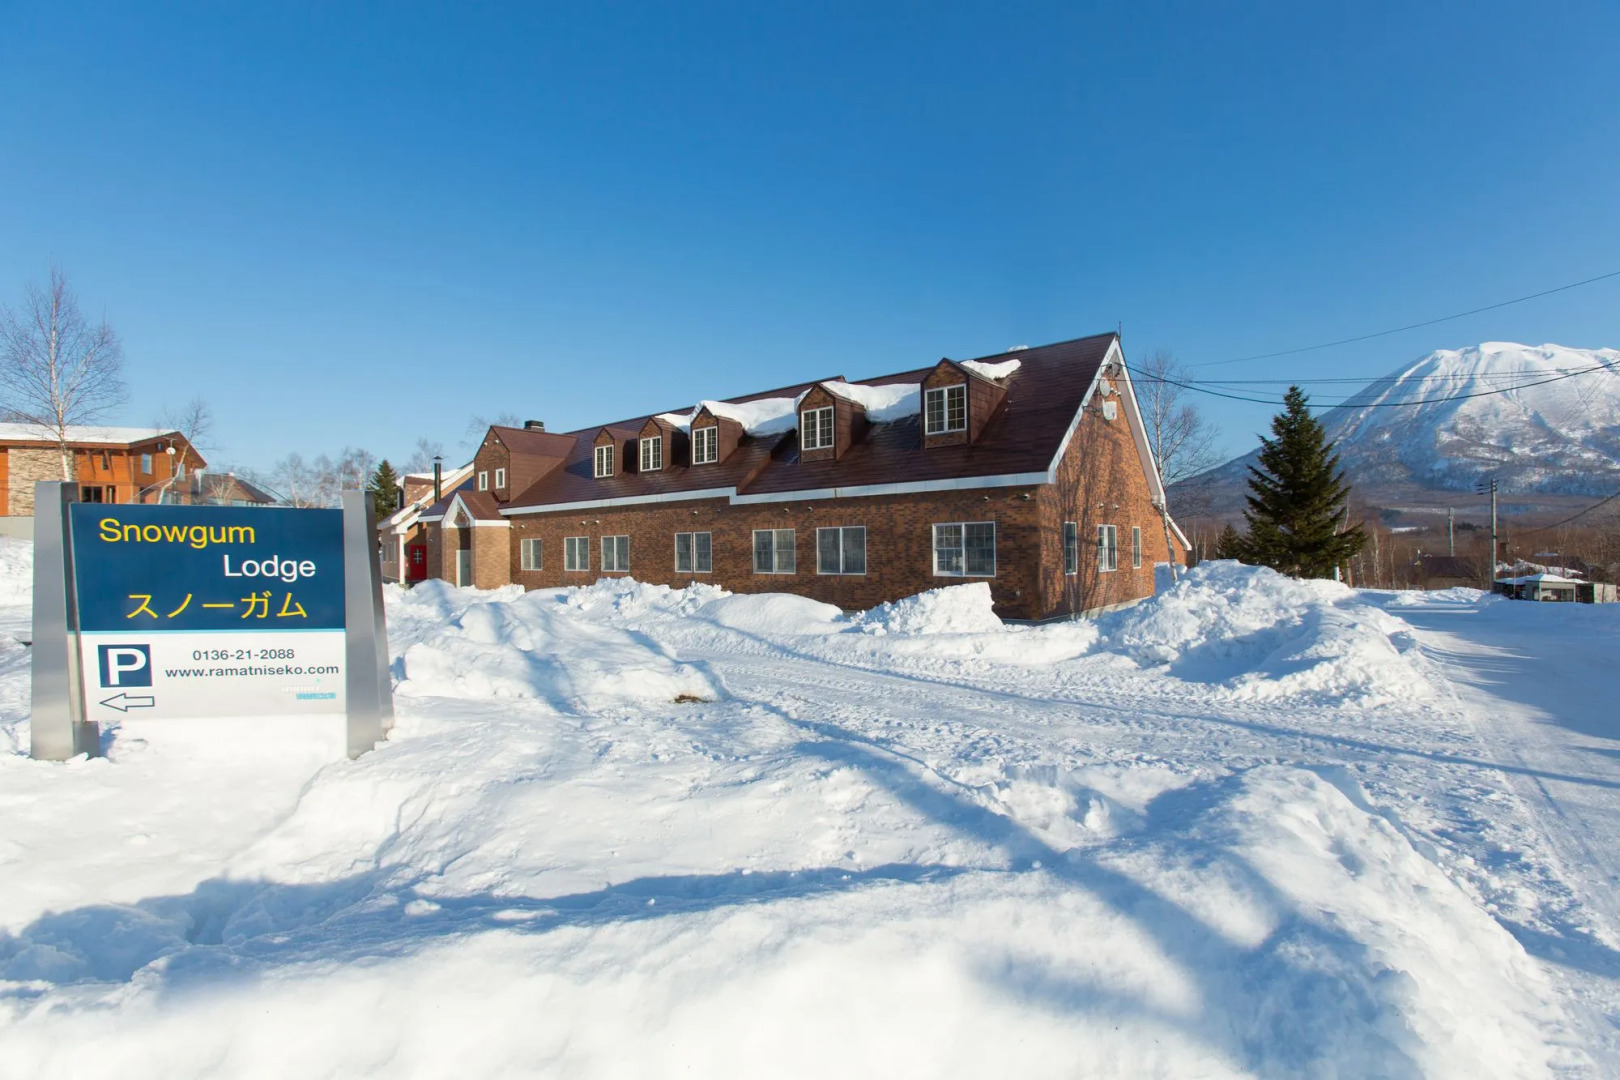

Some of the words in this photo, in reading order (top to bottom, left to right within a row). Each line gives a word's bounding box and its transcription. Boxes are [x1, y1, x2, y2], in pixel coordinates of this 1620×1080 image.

[99, 518, 256, 549] Snowgum
[223, 554, 316, 582] Lodge
[126, 591, 308, 619] スノーガム
[107, 648, 147, 685] P
[192, 649, 295, 661] 0136-21-2088
[165, 664, 340, 678] www.ramatniseko.com
